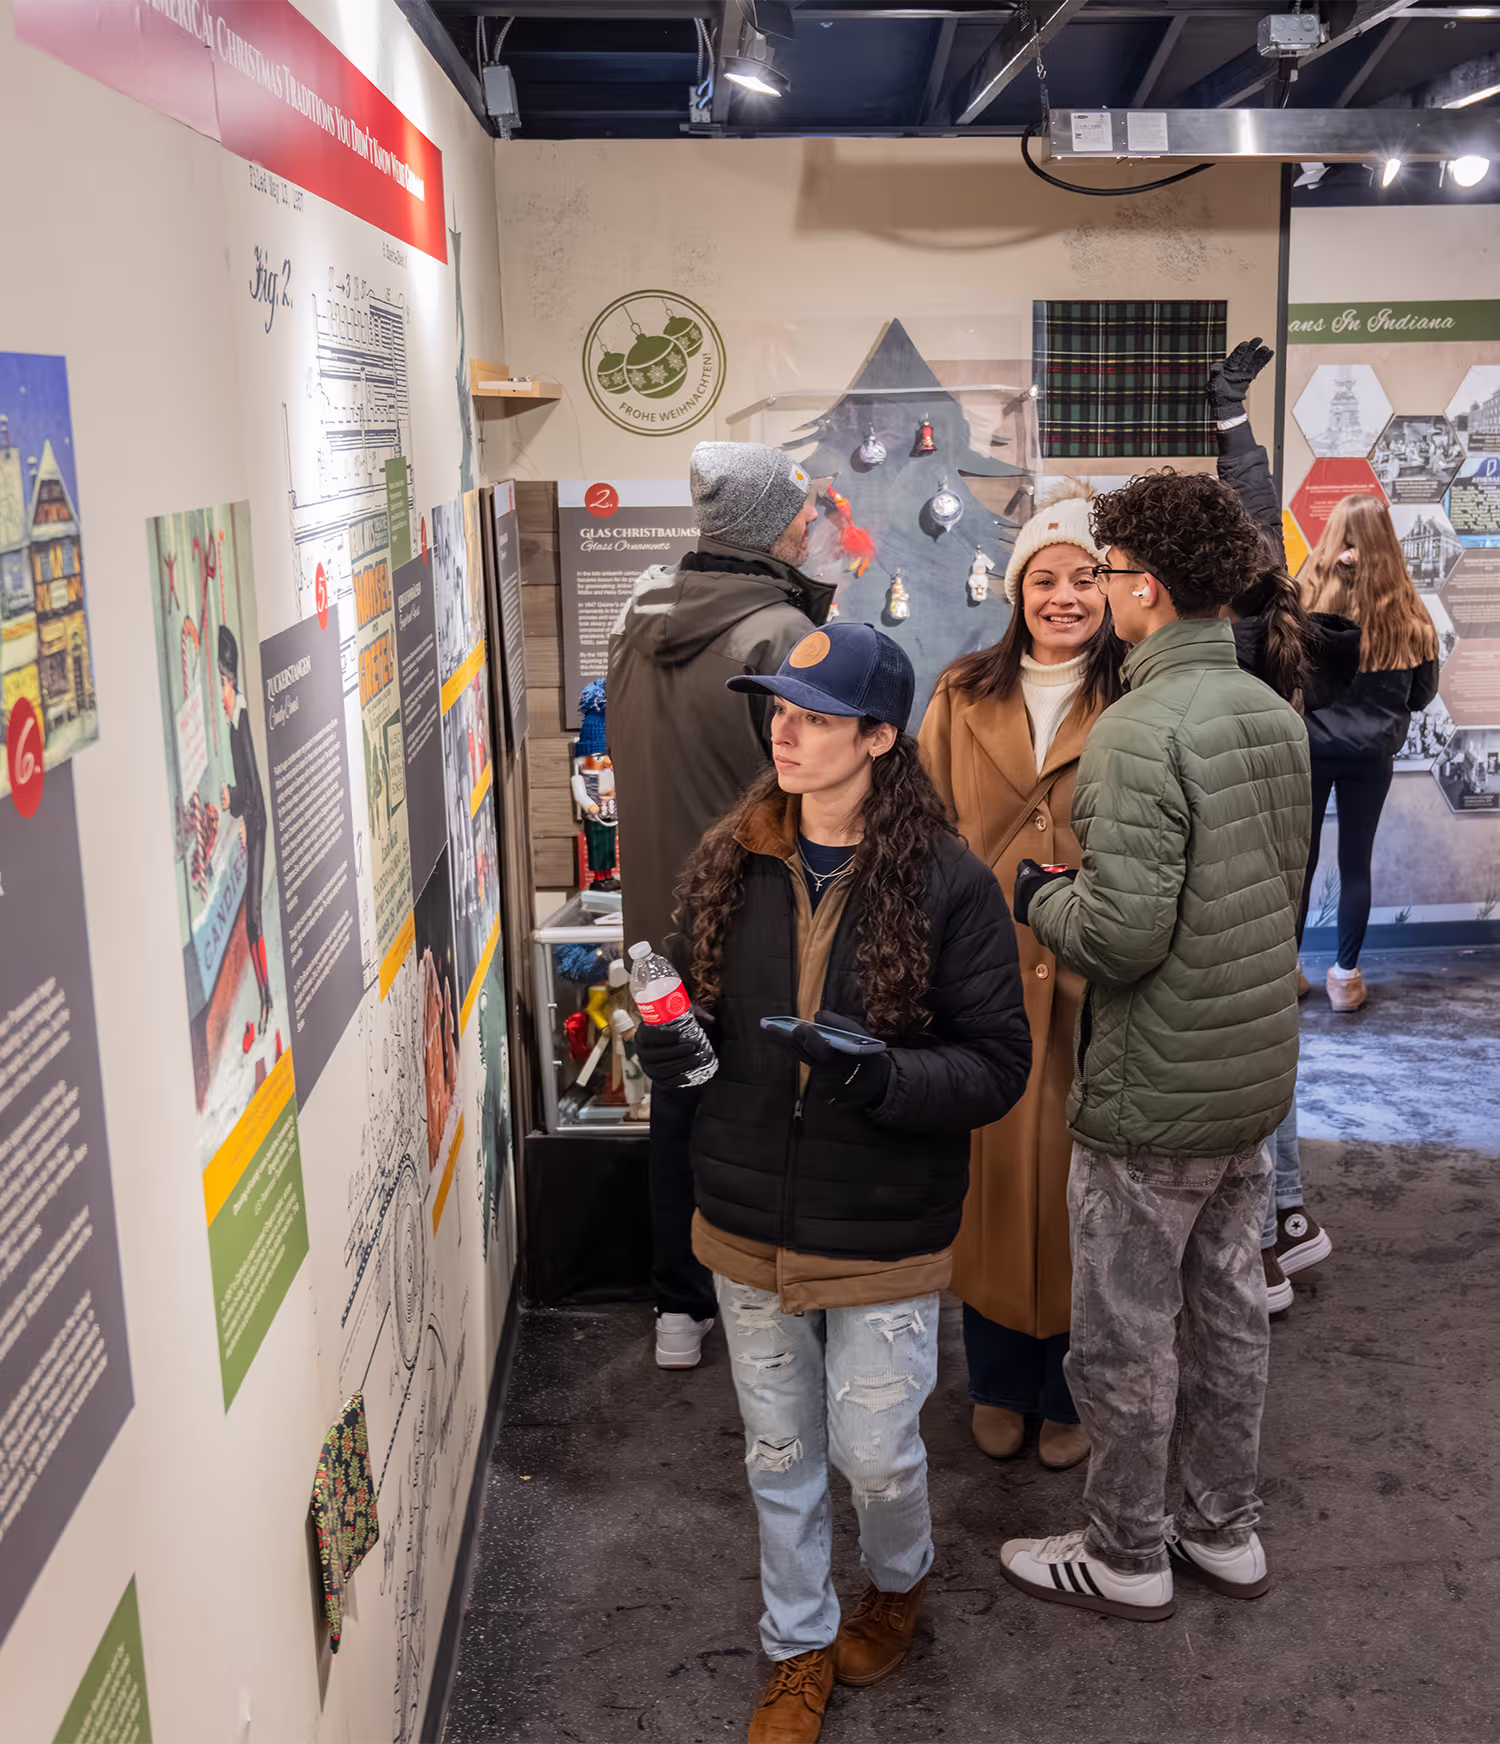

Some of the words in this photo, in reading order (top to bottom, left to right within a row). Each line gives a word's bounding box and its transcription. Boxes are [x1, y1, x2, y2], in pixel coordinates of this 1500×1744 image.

[217, 16, 283, 98] CHRISTMAS
[282, 64, 336, 136] TRADITIONS
[335, 105, 351, 148] YOU
[1331, 308, 1361, 333] In
[1367, 307, 1456, 333] Indiana
[619, 402, 656, 422] FROHE
[659, 352, 713, 422] WEIHNACHTEN!
[590, 489, 614, 509] 2.
[580, 528, 612, 540] GLAS
[580, 540, 613, 552] Glass
[614, 539, 671, 551] Ornaments
[352, 557, 392, 632] HANSEL
[266, 654, 312, 702] ZUCKERSTANGEN
[358, 629, 394, 712] GRETEL
[15, 717, 41, 785] 6.
[203, 847, 248, 974] CANDIES
